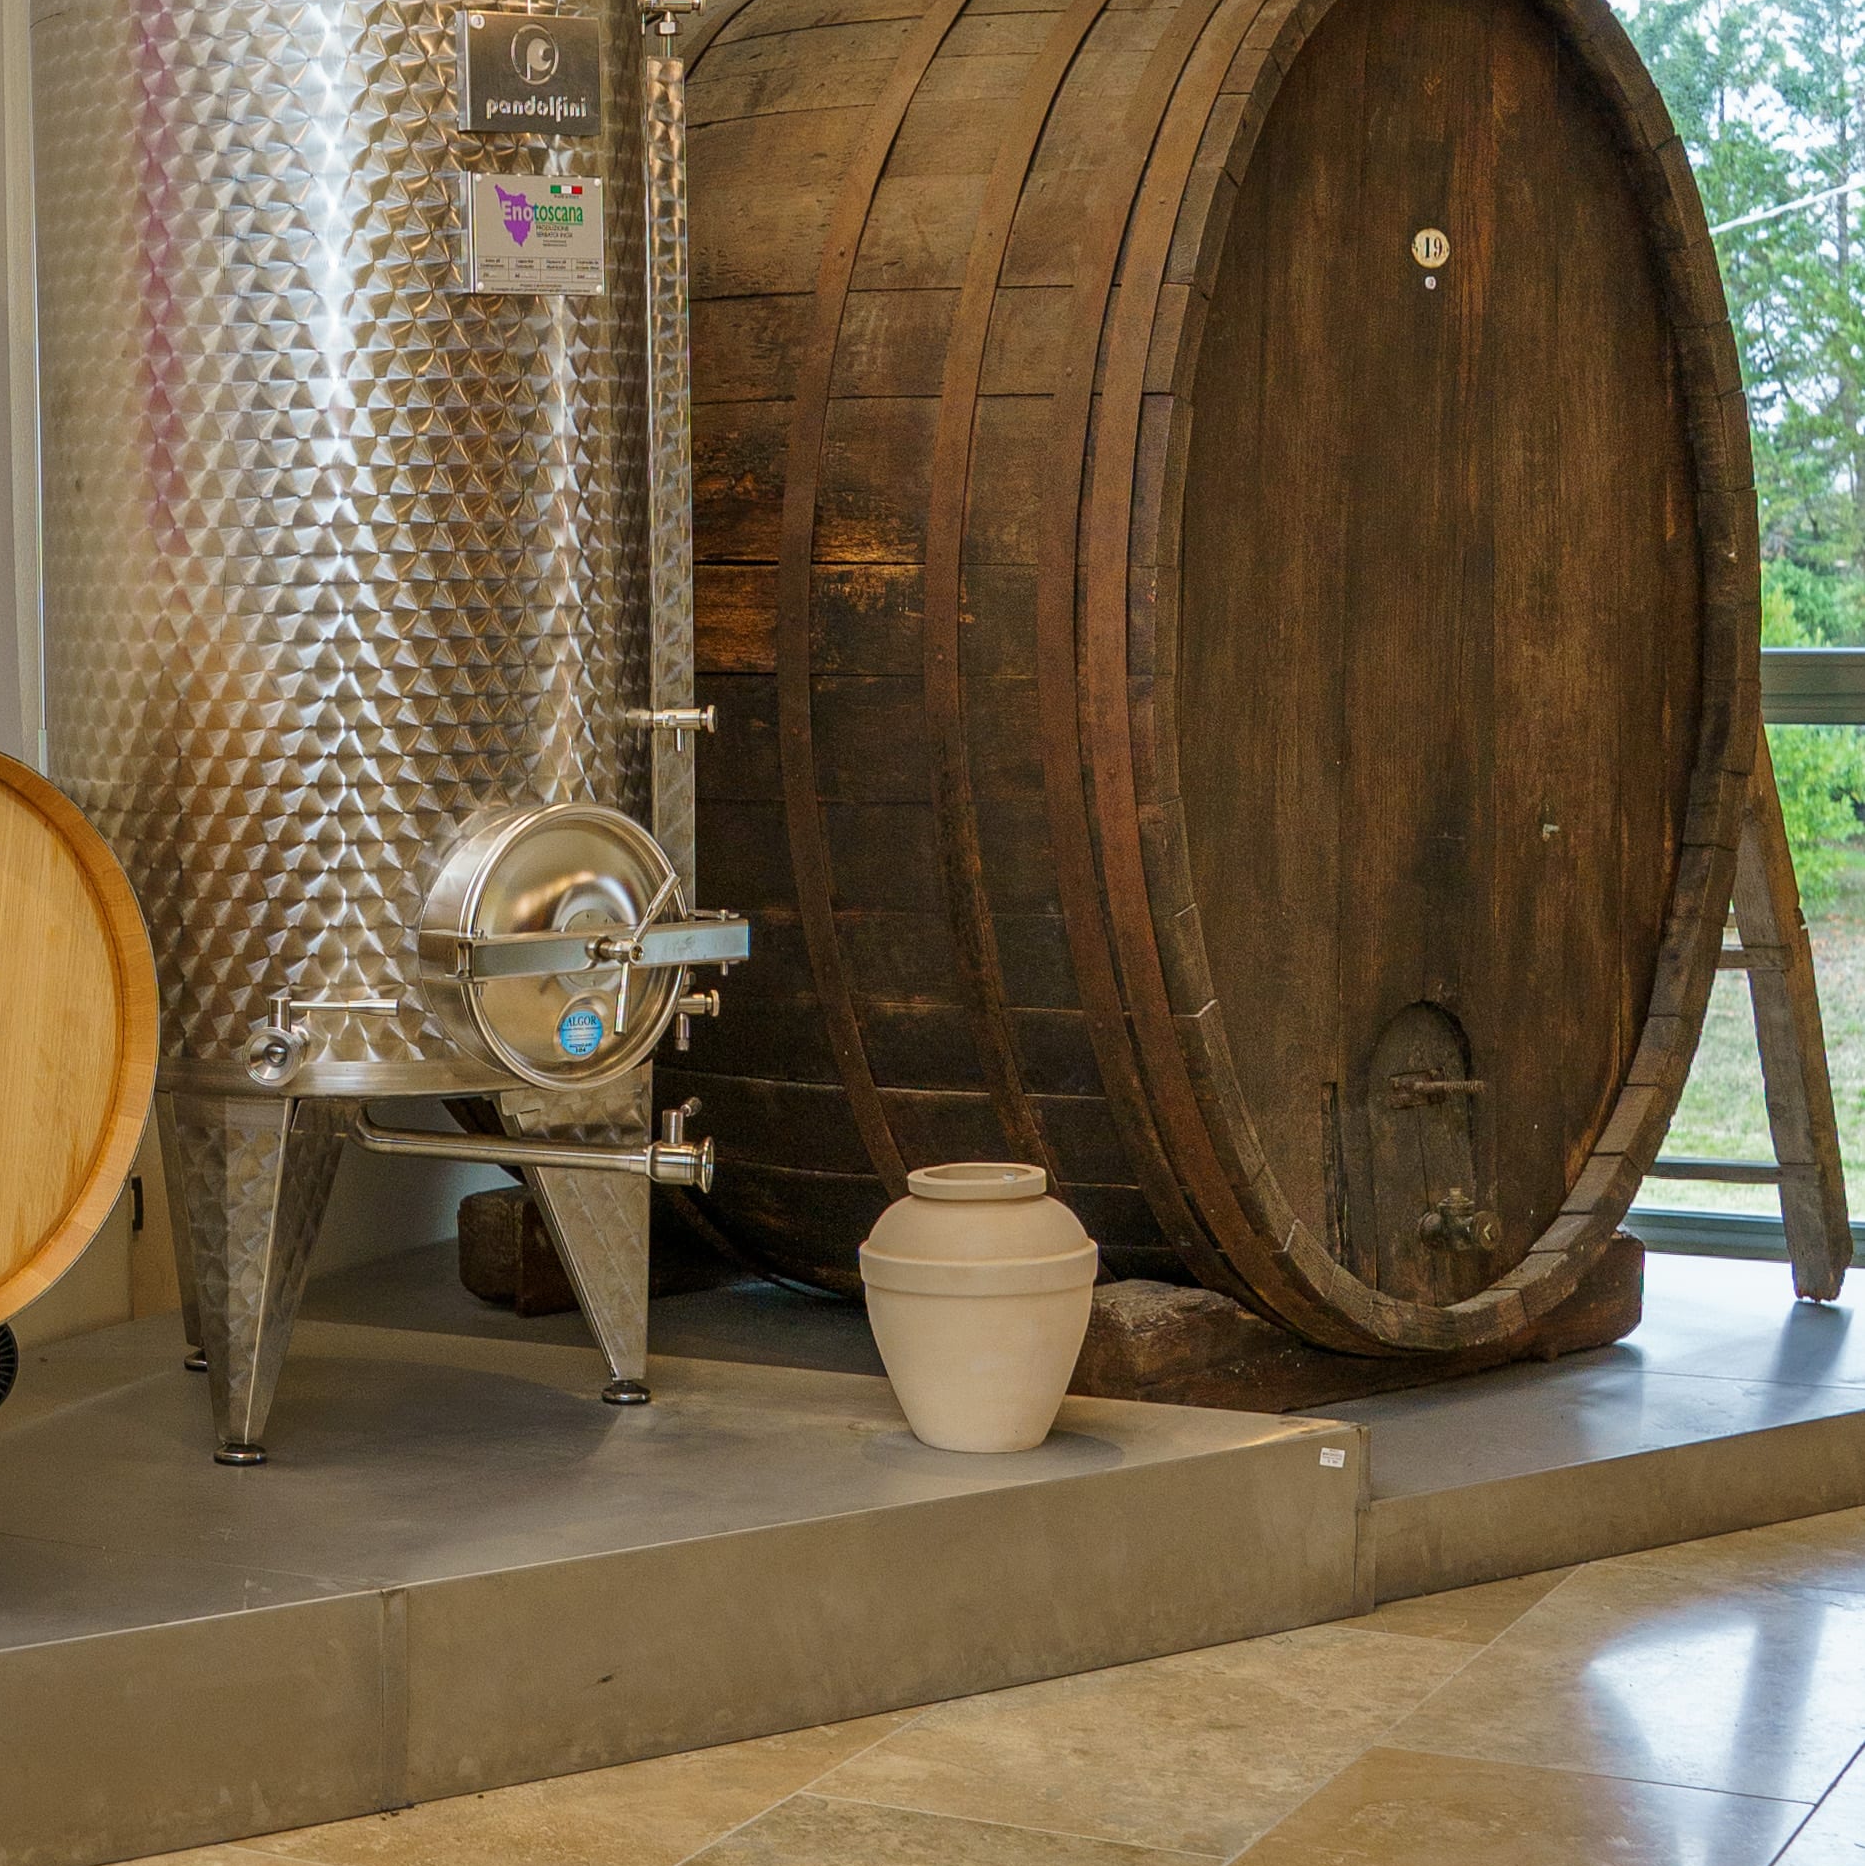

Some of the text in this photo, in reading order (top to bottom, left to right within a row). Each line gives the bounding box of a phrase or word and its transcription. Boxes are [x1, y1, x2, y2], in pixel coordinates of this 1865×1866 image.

[486, 94, 587, 123] pandolfini
[501, 200, 583, 223] Enotoscana
[1425, 236, 1443, 259] 19
[566, 1015, 597, 1027] ALGOR
